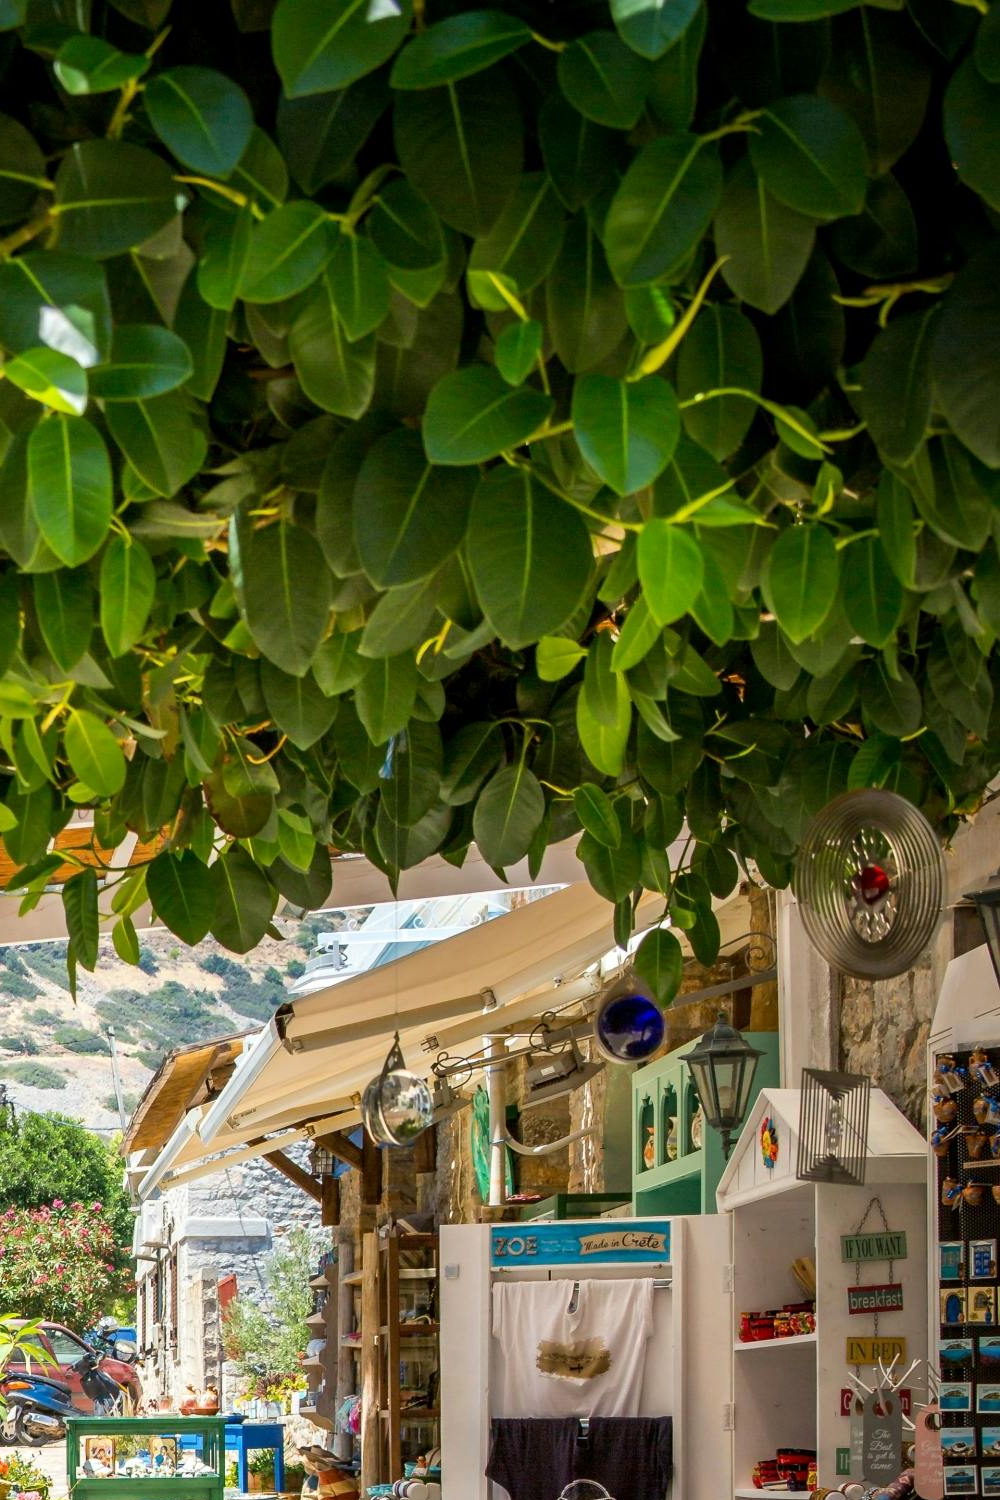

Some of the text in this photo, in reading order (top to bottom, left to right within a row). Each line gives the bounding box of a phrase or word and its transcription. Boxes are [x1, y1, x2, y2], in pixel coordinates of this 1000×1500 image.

[494, 1236, 537, 1257] ZOE
[584, 1238, 609, 1252] Made
[610, 1239, 620, 1248] in
[621, 1232, 660, 1249] Crete
[845, 1236, 901, 1258] IF YOU WANT
[850, 1289, 903, 1310] breakfast
[850, 1342, 903, 1360] IN BED
